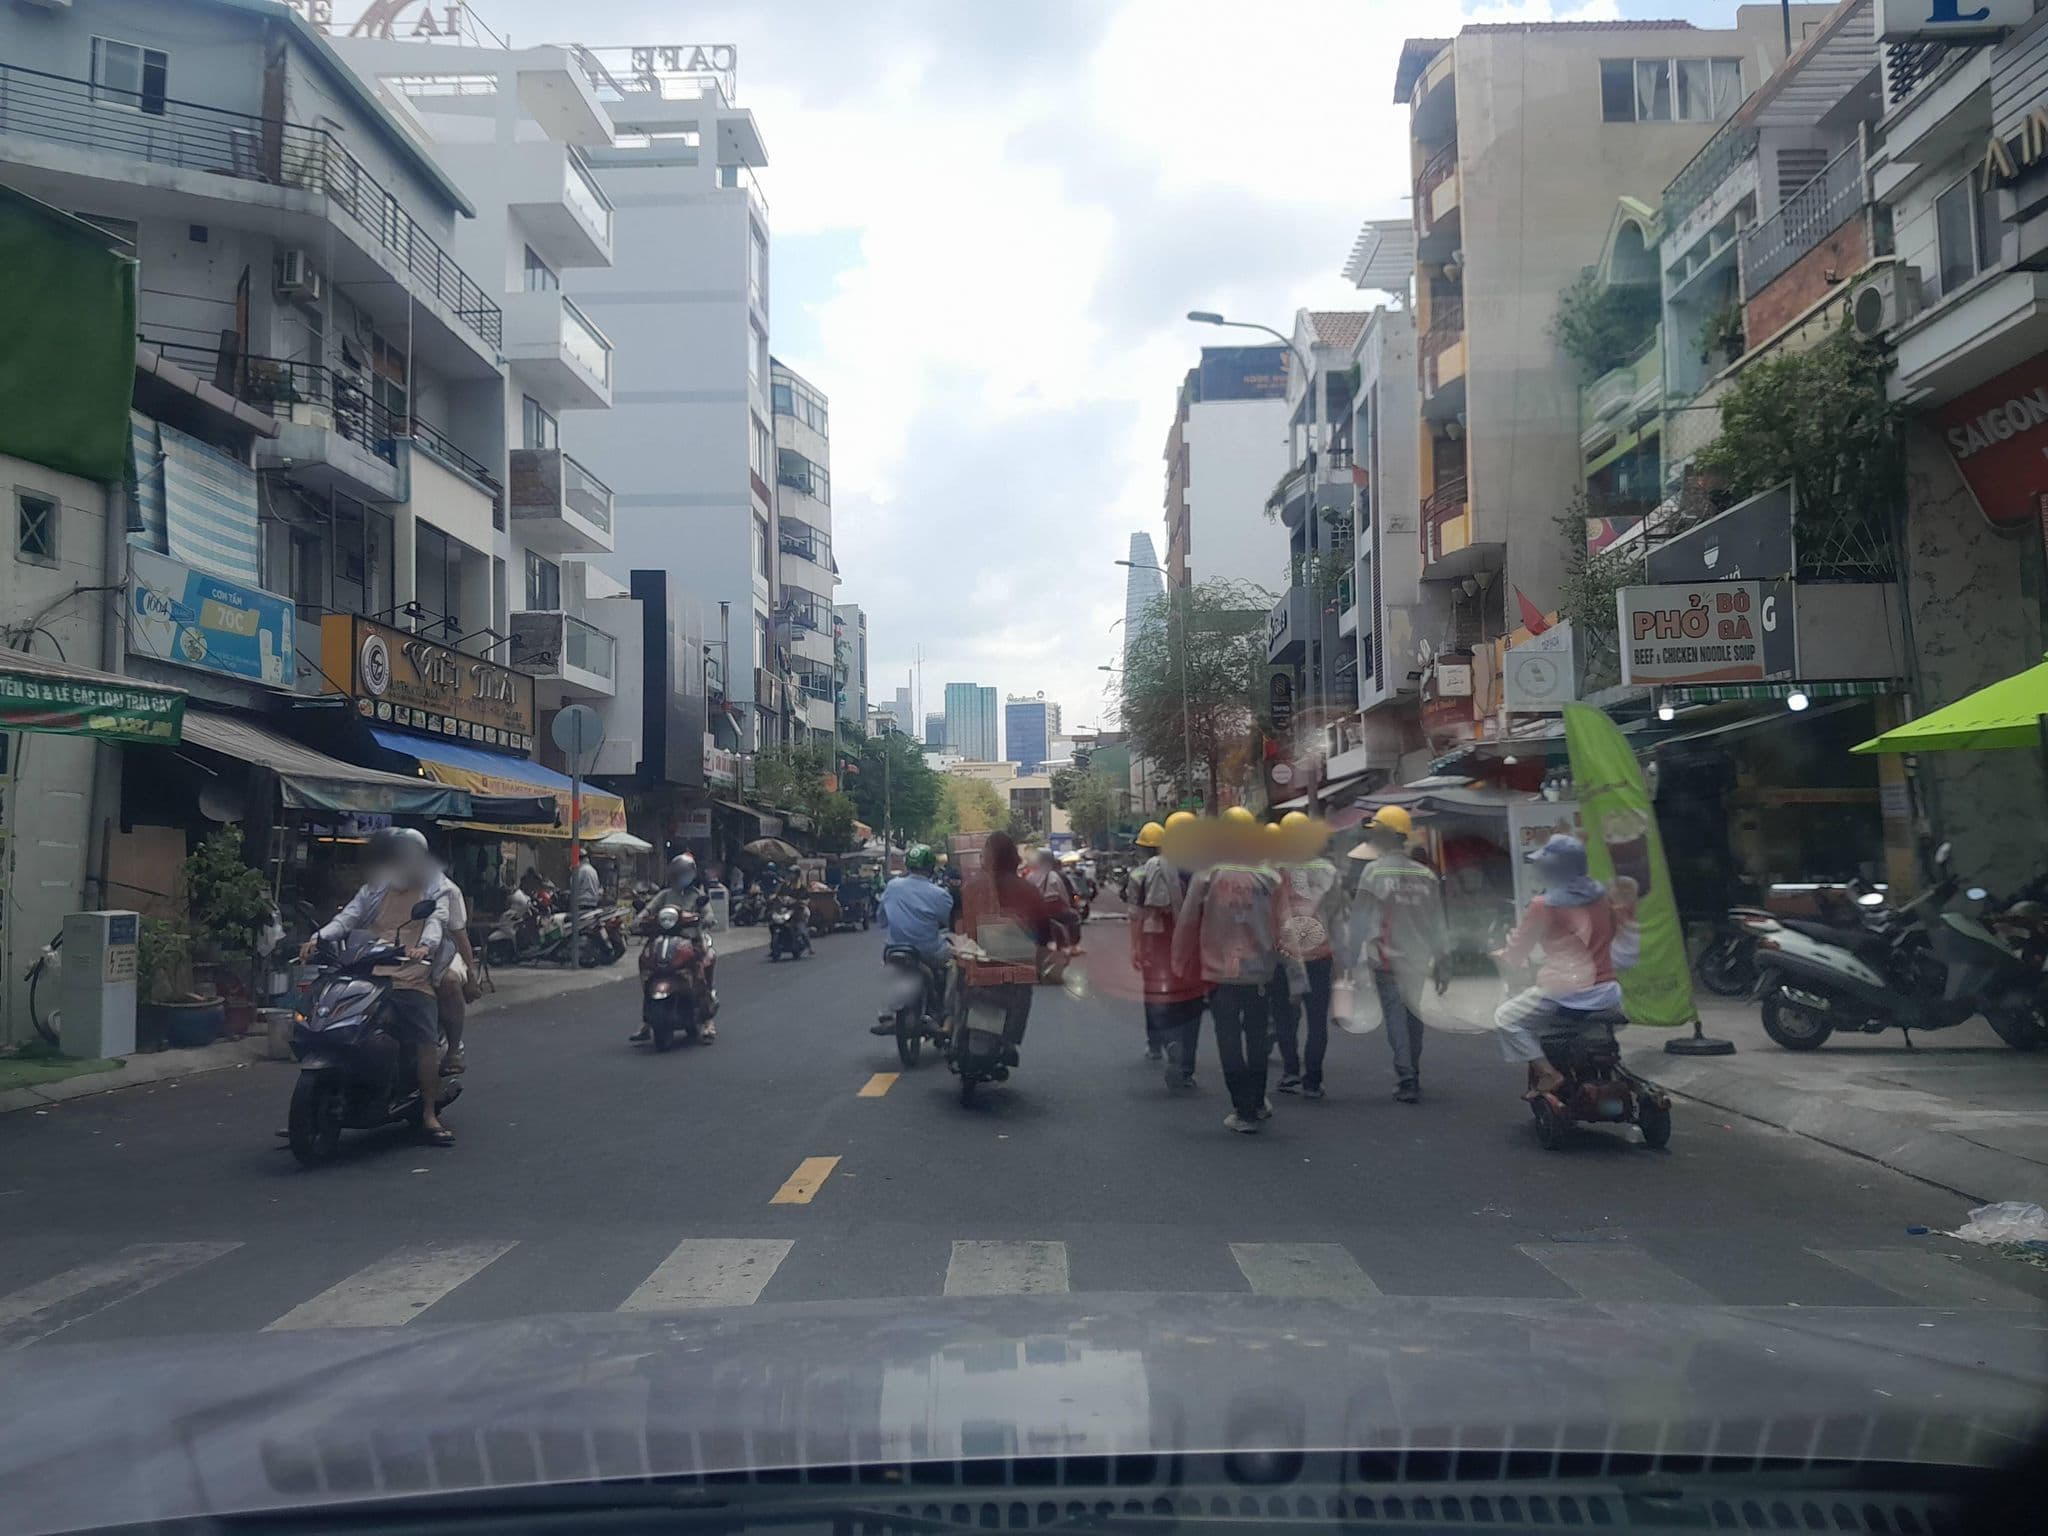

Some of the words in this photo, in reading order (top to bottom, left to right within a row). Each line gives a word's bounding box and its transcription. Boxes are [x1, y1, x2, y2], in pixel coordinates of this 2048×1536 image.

[1948, 386, 2048, 458] SAIGON
[1633, 594, 1709, 640] PHỞ
[1716, 588, 1750, 613] BÒ
[1634, 648, 1653, 665] BEEF
[1662, 646, 1698, 664] CHICKEN
[1700, 645, 1731, 663] NOODLE
[1733, 643, 1755, 661] SOUP
